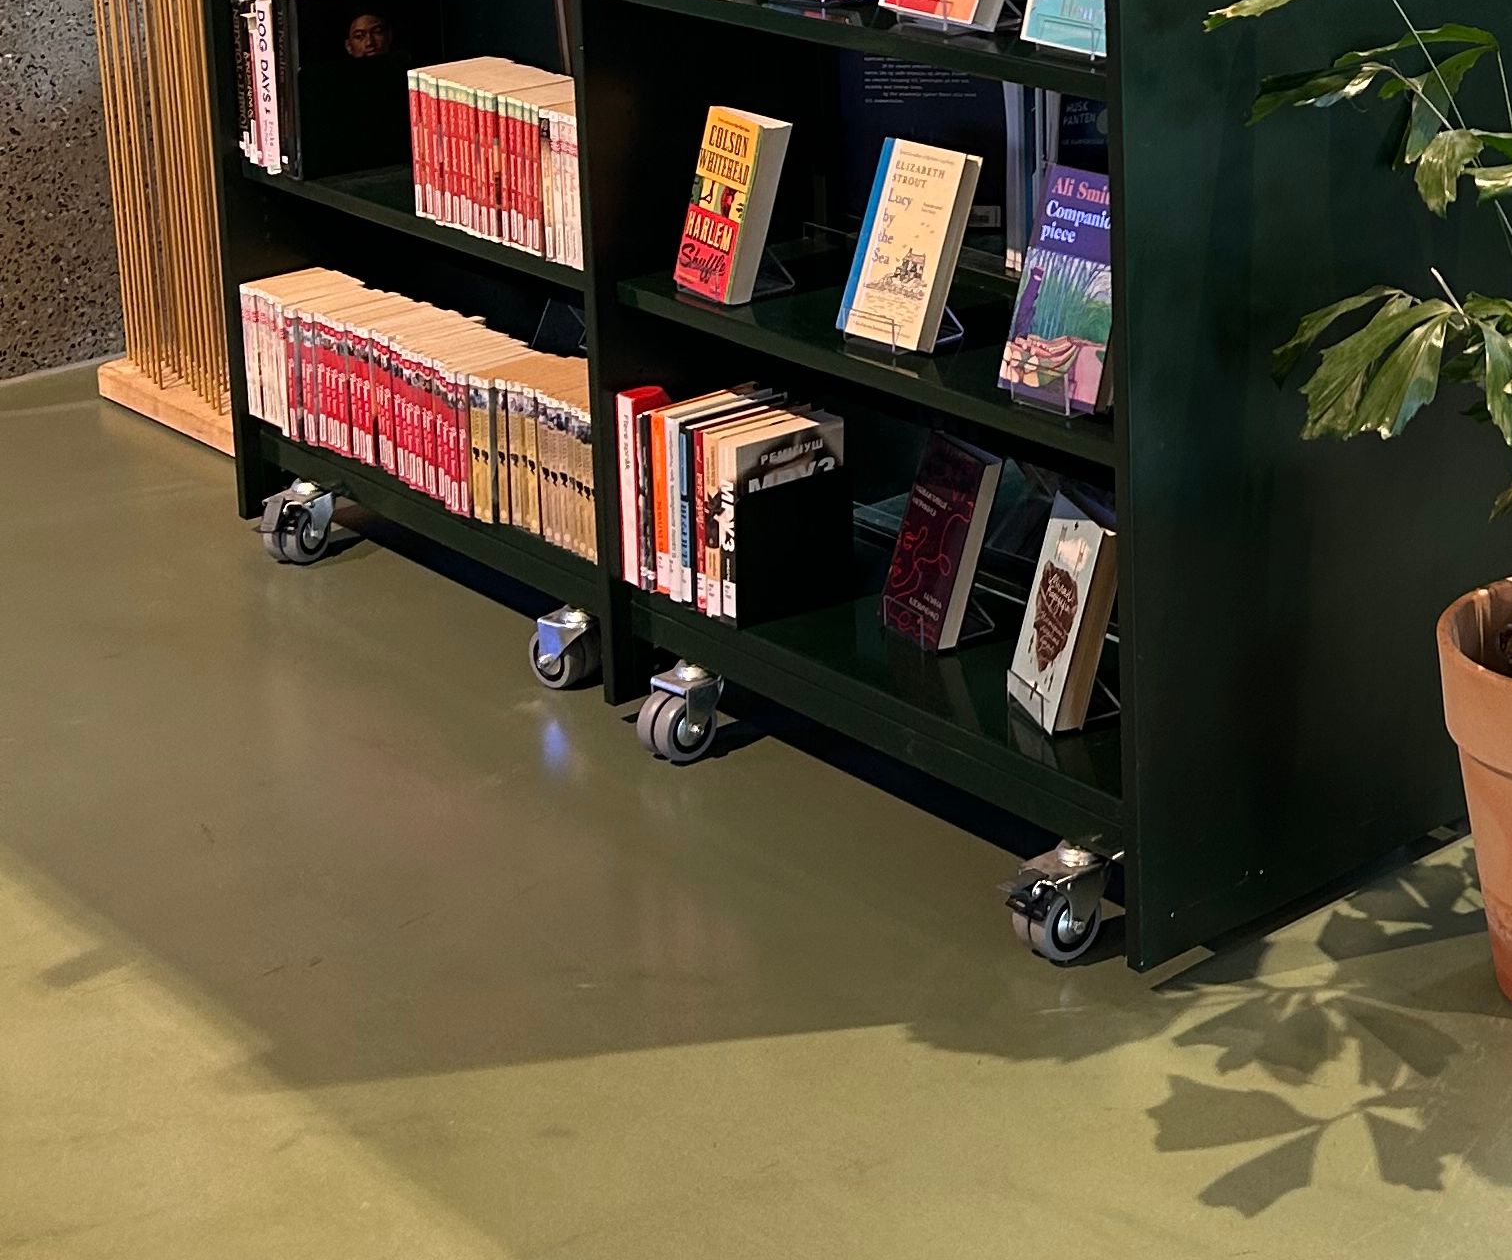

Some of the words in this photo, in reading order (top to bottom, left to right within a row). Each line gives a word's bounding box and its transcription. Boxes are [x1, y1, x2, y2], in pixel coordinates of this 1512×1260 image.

[257, 10, 268, 52] DOG
[260, 60, 271, 102] DAYS
[708, 125, 749, 158] COLSON
[699, 148, 750, 185] WHITEHEAD
[896, 160, 946, 179] ELIZABETH
[891, 173, 928, 189] STROUT
[1052, 177, 1075, 197] Ali
[888, 188, 913, 211] Lucy
[883, 208, 896, 227] by
[685, 210, 733, 253] HARLEM
[878, 231, 894, 245] the
[1039, 221, 1077, 243] piece
[681, 243, 726, 284] Shuffle
[872, 247, 890, 265] Sea
